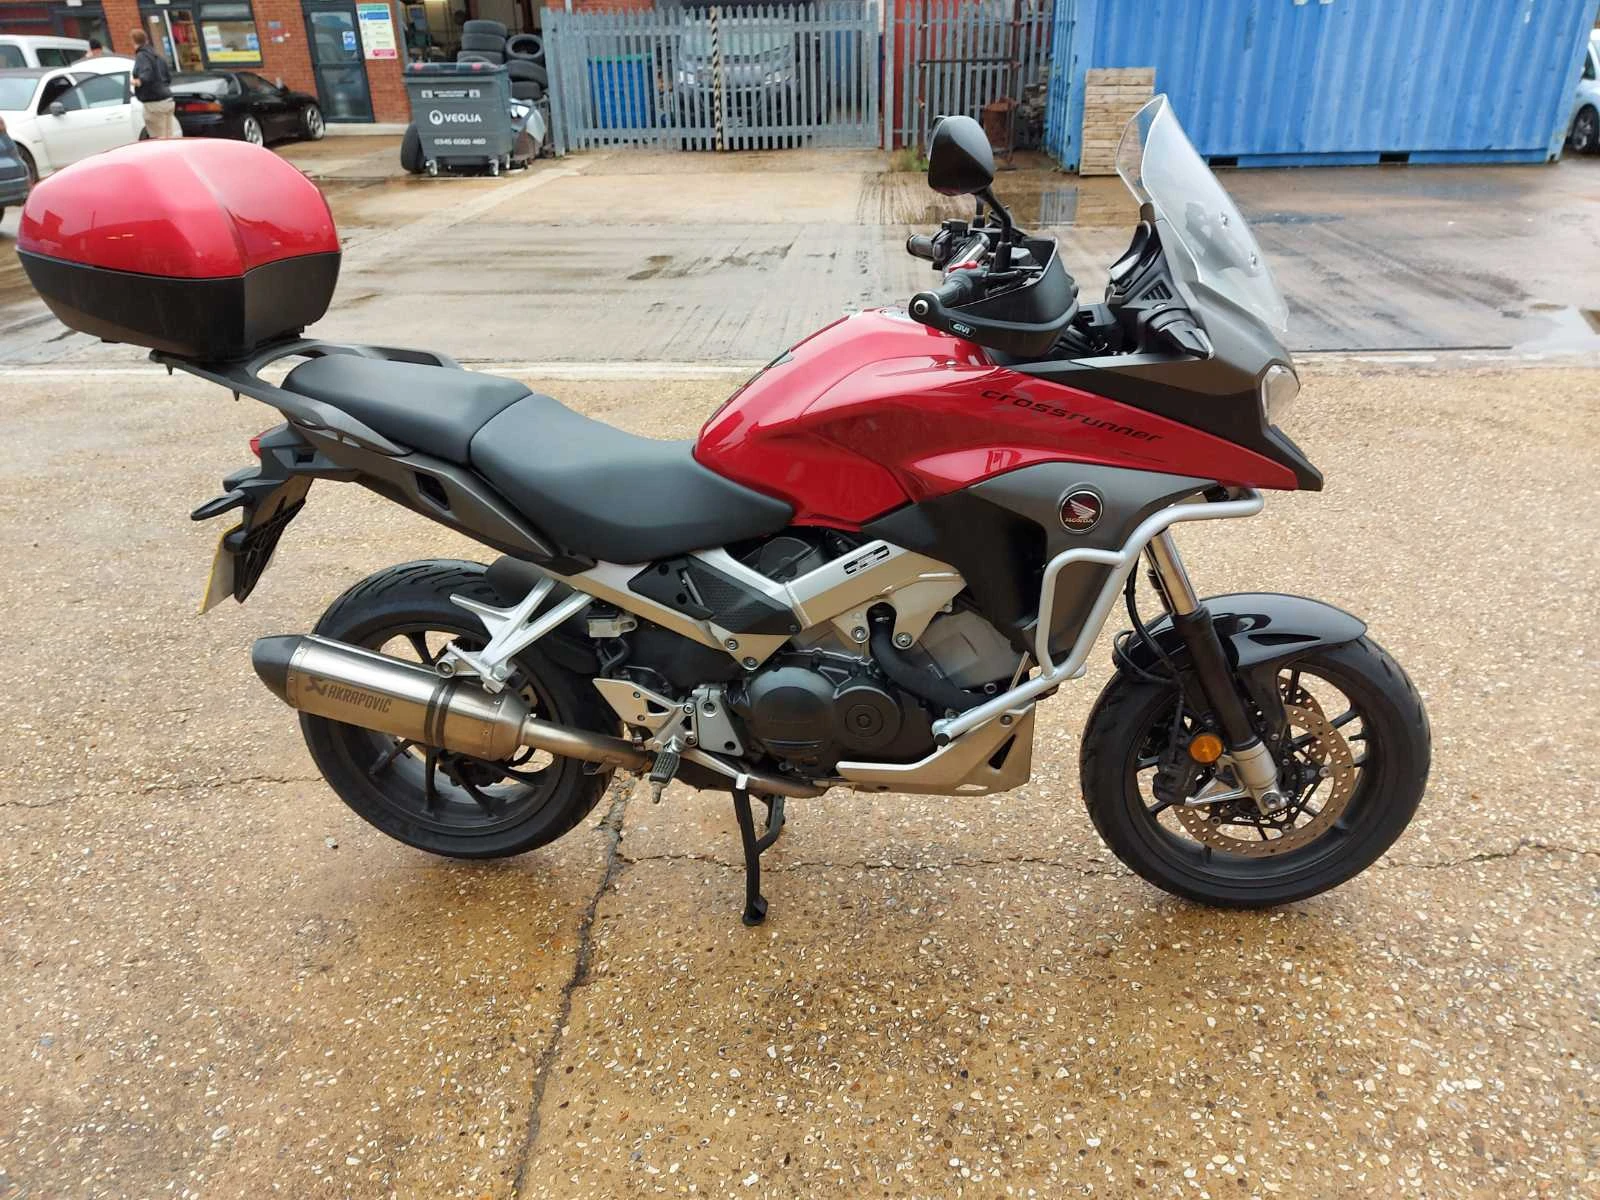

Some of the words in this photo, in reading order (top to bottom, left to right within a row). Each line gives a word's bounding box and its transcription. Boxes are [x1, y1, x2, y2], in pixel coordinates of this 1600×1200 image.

[444, 113, 482, 123] VEOLIA
[953, 323, 970, 334] GIVI
[981, 389, 1164, 442] crossrunner
